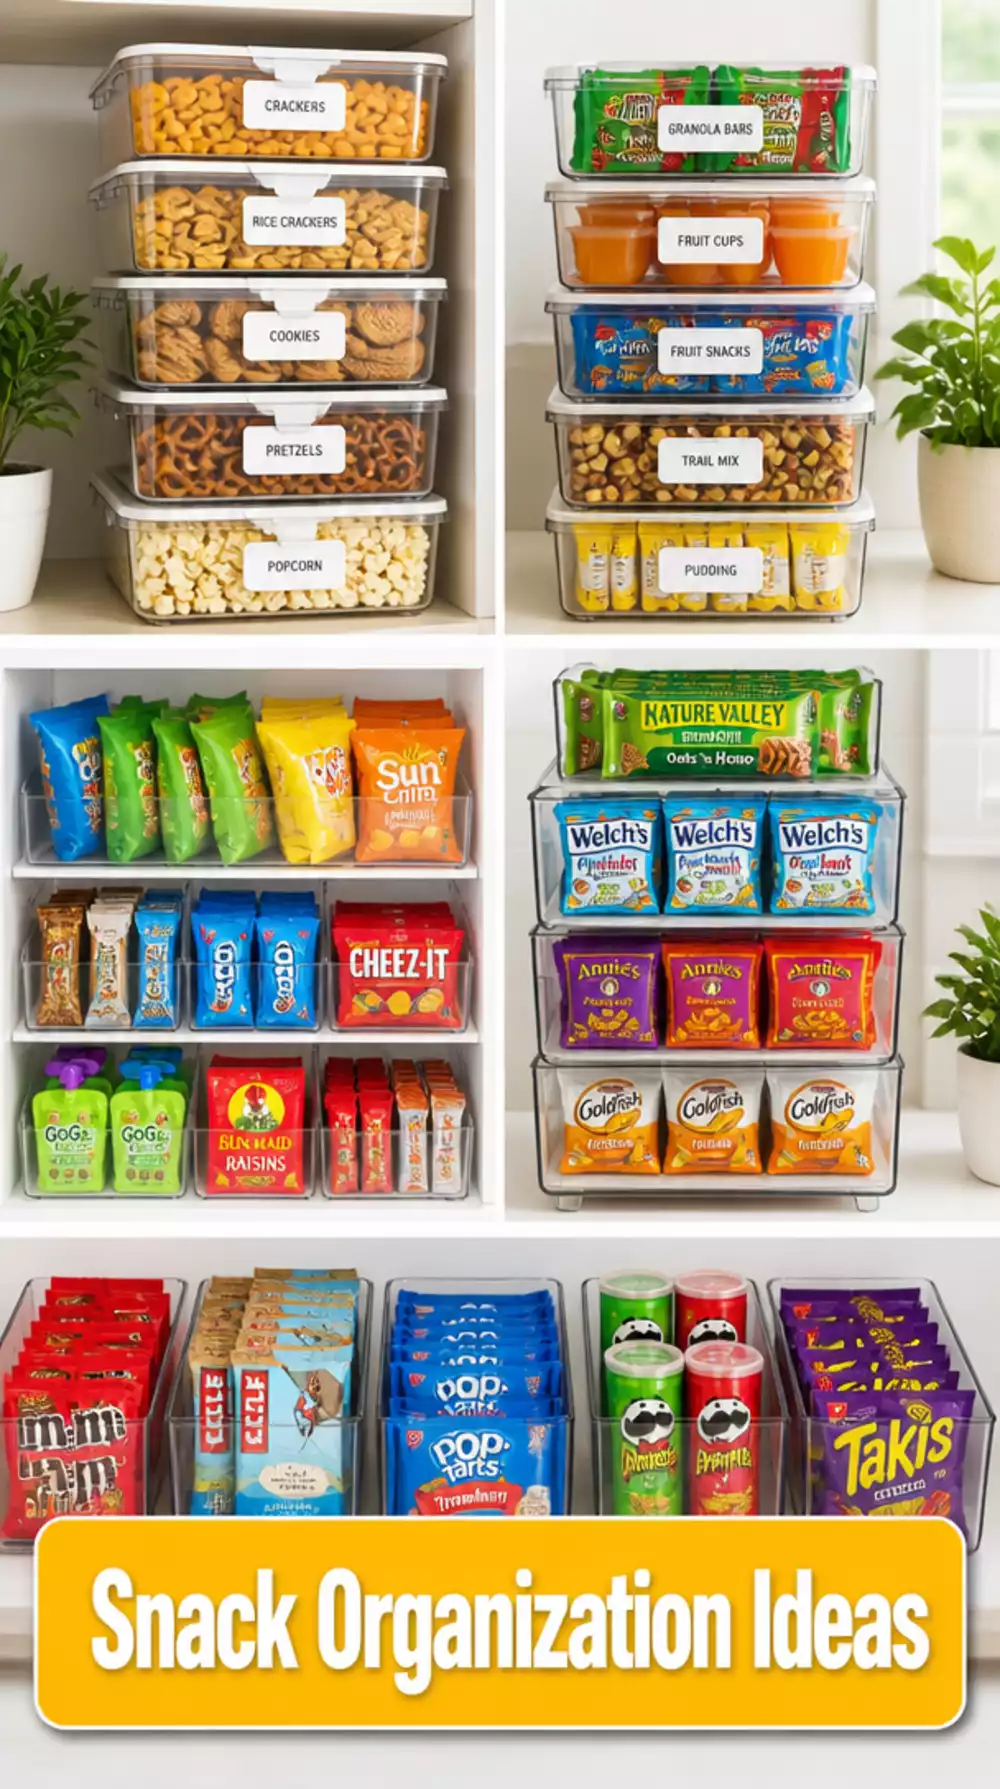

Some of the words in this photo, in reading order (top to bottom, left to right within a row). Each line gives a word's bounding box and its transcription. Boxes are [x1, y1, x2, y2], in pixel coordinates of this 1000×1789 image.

[265, 99, 326, 113] CRACKERS
[668, 122, 721, 136] GRANOLA
[724, 122, 753, 136] BARS
[252, 216, 278, 228] RICE
[280, 216, 338, 228] CRACKERS
[678, 234, 710, 248] FRUIT
[713, 234, 744, 248] CUPS
[269, 330, 321, 343] COOKIES
[670, 344, 702, 358] FRUIT
[706, 344, 751, 358] SNACKS
[265, 444, 323, 457] PRETZELS
[682, 454, 714, 467] TRAIL
[717, 454, 740, 467] MIX
[267, 560, 322, 573] POPCORN
[684, 564, 738, 577] PUDDING
[643, 702, 717, 726] NATURE
[718, 702, 785, 727] VALLEY
[376, 759, 442, 790] Sun
[570, 820, 649, 849] Welch's
[673, 819, 753, 848] Welch's
[781, 820, 864, 848] Welch's
[349, 947, 450, 980] CHEEZ-IT
[225, 1155, 287, 1172] RAISINS
[833, 1415, 954, 1498] Takis
